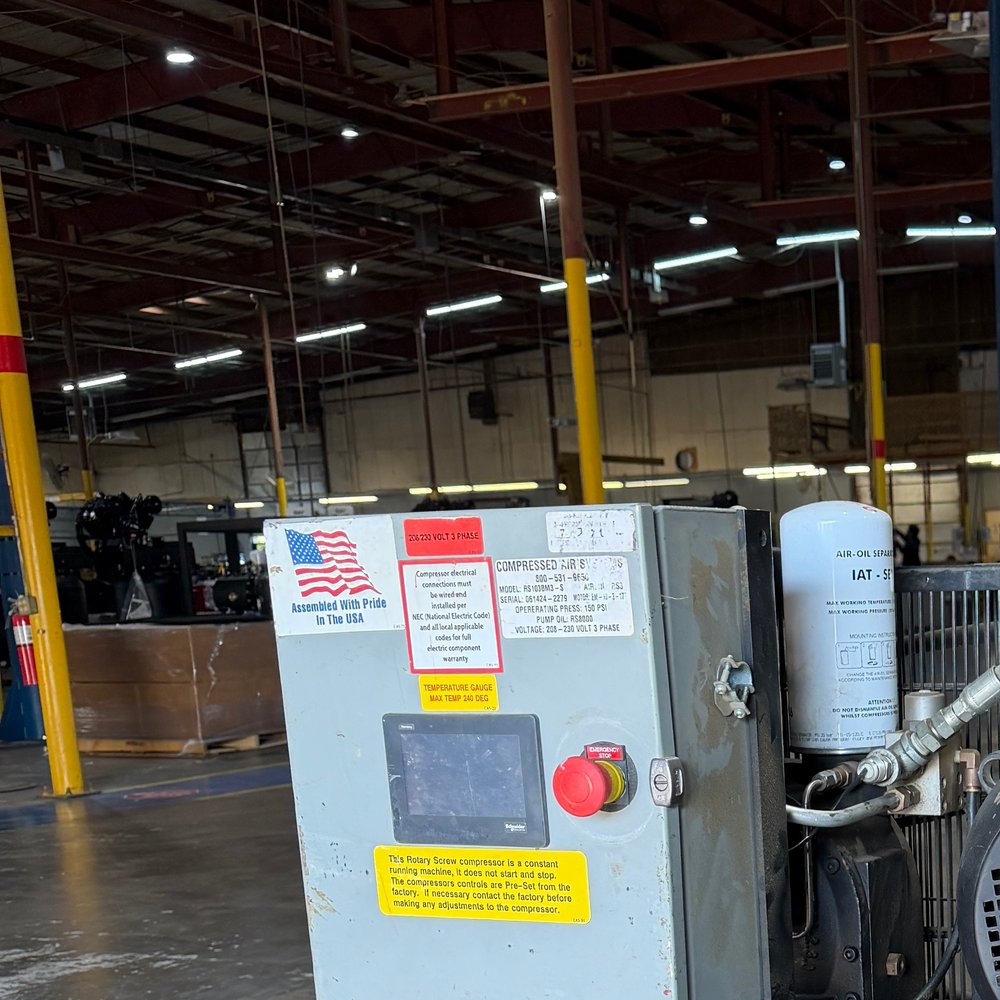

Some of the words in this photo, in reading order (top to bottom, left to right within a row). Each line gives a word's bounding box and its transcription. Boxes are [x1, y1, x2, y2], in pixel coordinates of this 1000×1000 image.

[451, 532, 456, 540] 3
[457, 532, 480, 540] PHASE
[836, 550, 871, 558] AIR-OIL
[496, 559, 558, 572] COMPRESSED
[561, 558, 577, 570] AIR
[415, 570, 450, 579] Compressor
[852, 569, 872, 581] IAT
[499, 585, 521, 593] MODEL:
[500, 595, 524, 604] SERIAL:
[292, 601, 338, 613] Assembled
[340, 599, 360, 611] With
[363, 598, 387, 609] Pride
[515, 605, 558, 614] OPERERATING
[560, 604, 582, 613] PRESS:
[584, 604, 595, 612] 150
[596, 603, 608, 612] PSI
[317, 615, 325, 625] In
[327, 614, 344, 625] The
[346, 613, 364, 624] USA
[425, 612, 451, 620] (National
[451, 612, 473, 620] Electric
[473, 611, 491, 619] Code)
[536, 615, 554, 624] PUMP
[556, 615, 569, 623] OIL:
[454, 622, 484, 631] applicable
[514, 625, 545, 634] VOLTAGE:
[576, 624, 592, 633] VOLT
[593, 624, 598, 632] 3
[599, 623, 620, 632] PHASE
[461, 633, 472, 641] full
[430, 694, 444, 702] MAX
[445, 694, 462, 702] TEMP
[463, 694, 474, 702] 240
[475, 694, 489, 702] DEG
[406, 855, 431, 865] Rotary
[433, 856, 457, 865] Screw
[459, 858, 505, 867] compressor
[507, 859, 515, 867] is
[524, 860, 559, 868] constant
[389, 867, 418, 876] running
[420, 867, 454, 877] machine,
[456, 868, 461, 876] it
[463, 868, 482, 877] does
[500, 870, 518, 878] start
[520, 871, 535, 879] and
[537, 872, 557, 880] stop.
[390, 877, 404, 885] The
[406, 878, 455, 887] compressors
[457, 880, 488, 888] controls
[505, 881, 535, 890] Pre-Set
[538, 882, 556, 891] from
[558, 883, 571, 891] the
[391, 888, 420, 898] factory.
[424, 889, 429, 897] If
[431, 890, 470, 900] necessary
[472, 892, 501, 900] contact
[503, 892, 515, 900] the
[517, 893, 544, 903] factory
[546, 894, 572, 902] before
[393, 900, 420, 909] making
[422, 901, 435, 910] any
[438, 901, 484, 911] adjustments
[486, 903, 495, 911] to
[496, 903, 509, 911] the
[511, 905, 560, 914] compressor.
